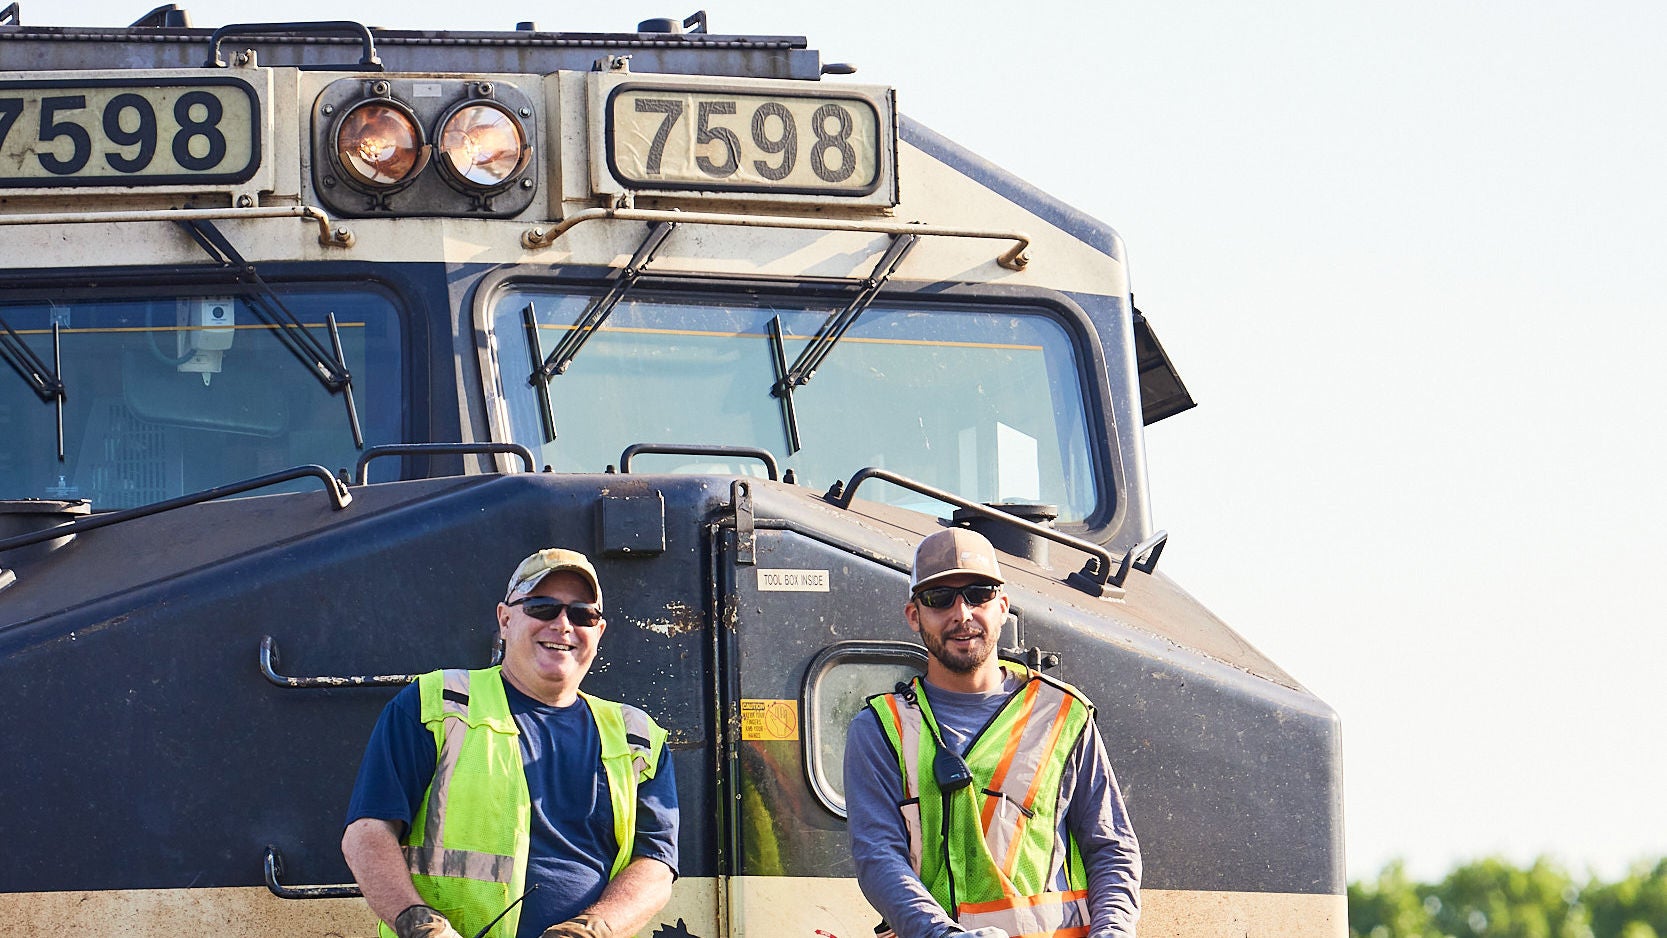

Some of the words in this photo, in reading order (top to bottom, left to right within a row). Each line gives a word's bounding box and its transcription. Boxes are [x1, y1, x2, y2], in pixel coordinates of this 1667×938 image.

[634, 98, 857, 183] 7598
[764, 574, 782, 585] TOOL
[785, 575, 798, 586] BOX
[801, 575, 823, 586] INSIDE
